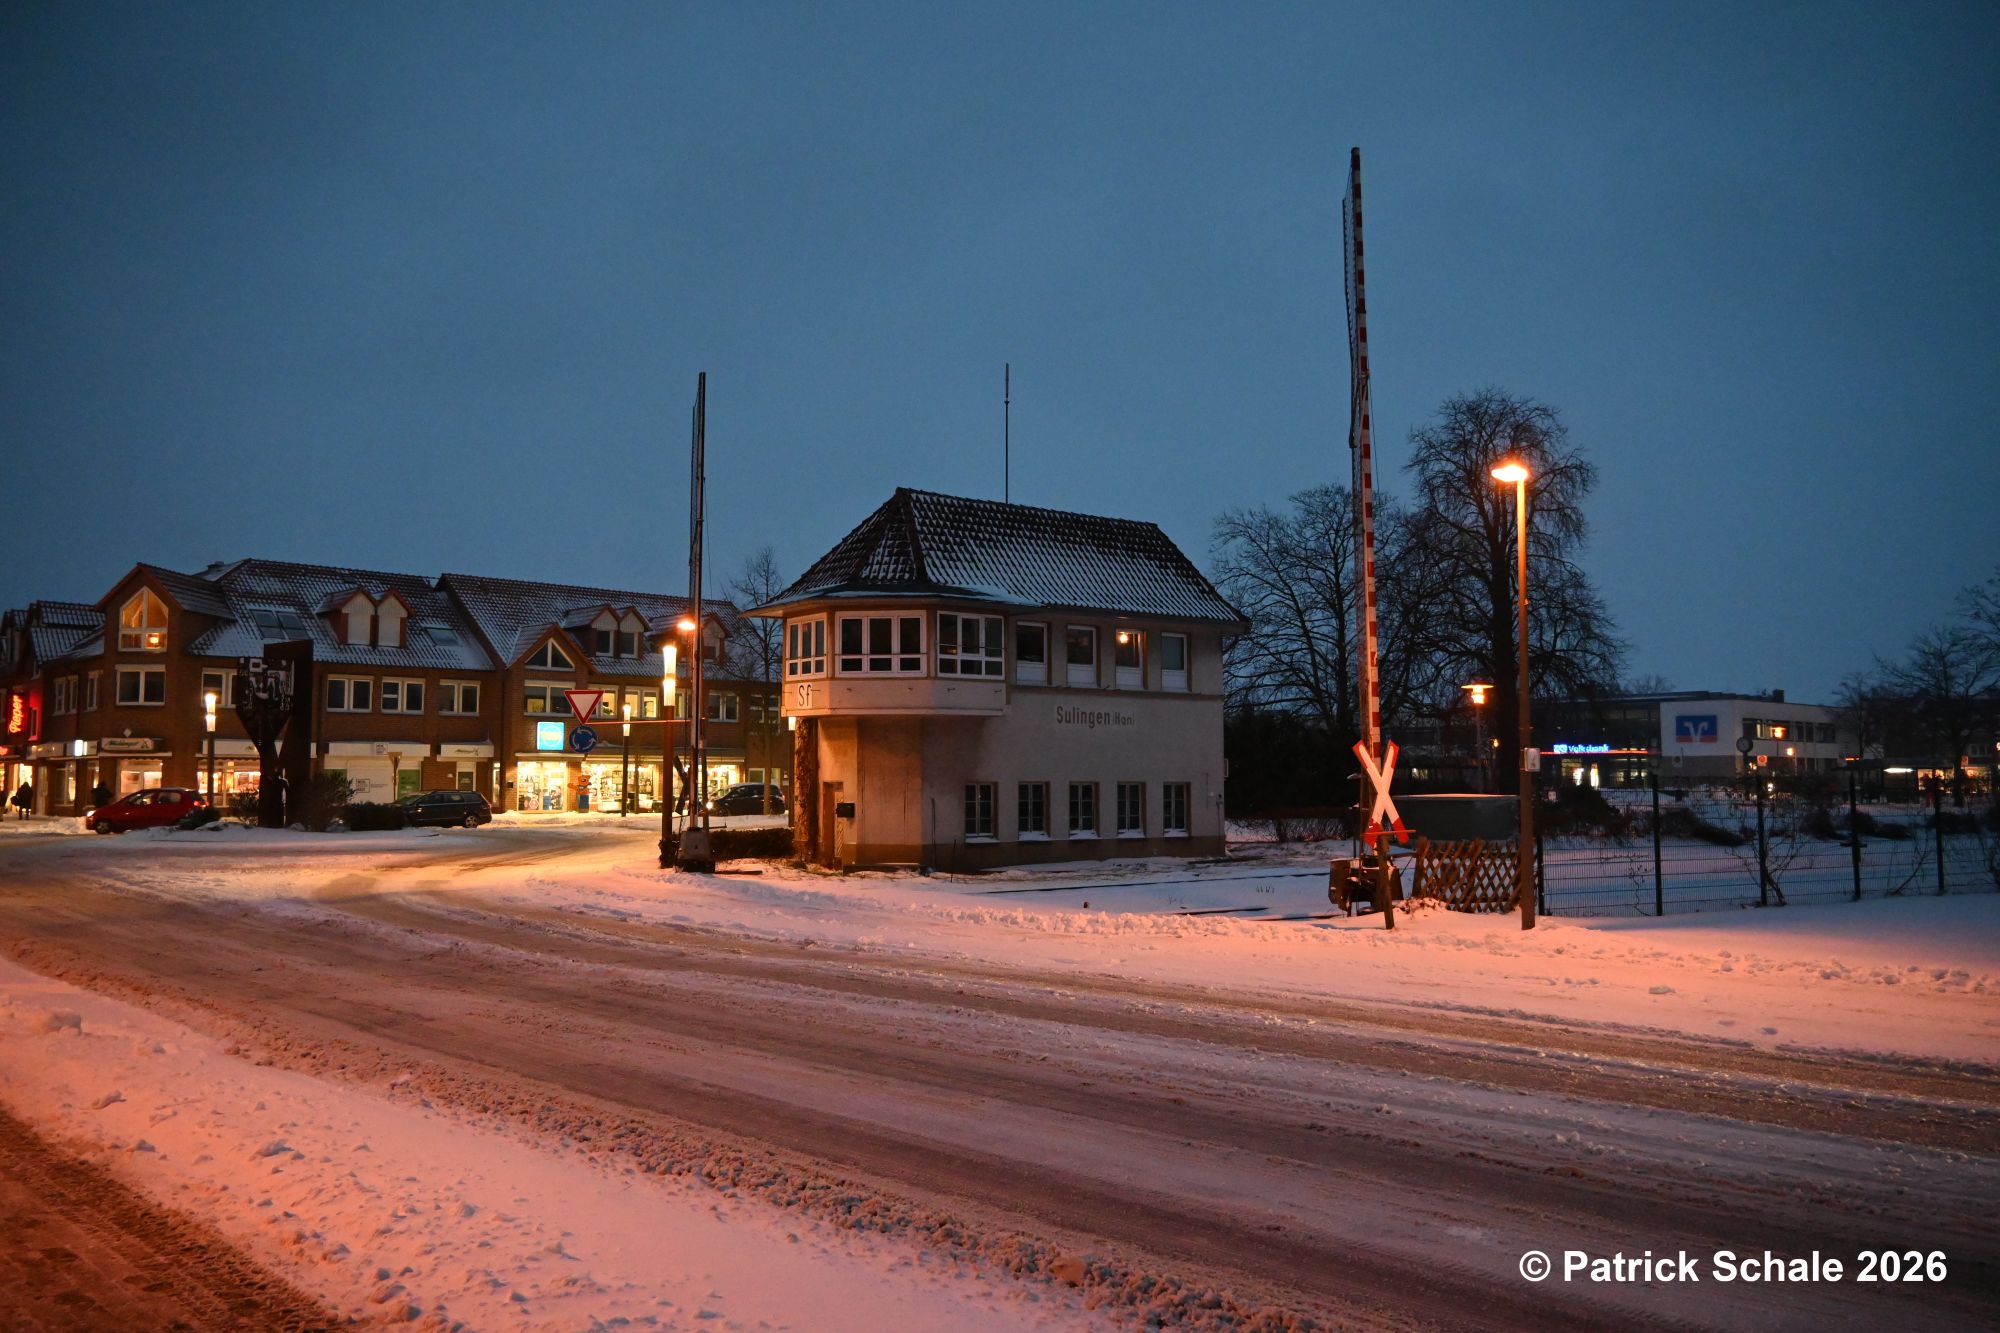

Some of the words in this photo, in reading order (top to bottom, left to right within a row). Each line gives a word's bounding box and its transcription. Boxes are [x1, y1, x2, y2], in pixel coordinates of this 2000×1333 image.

[798, 684, 812, 707] Sf
[9, 694, 23, 733] Pieper
[1056, 706, 1111, 729] Sulingen
